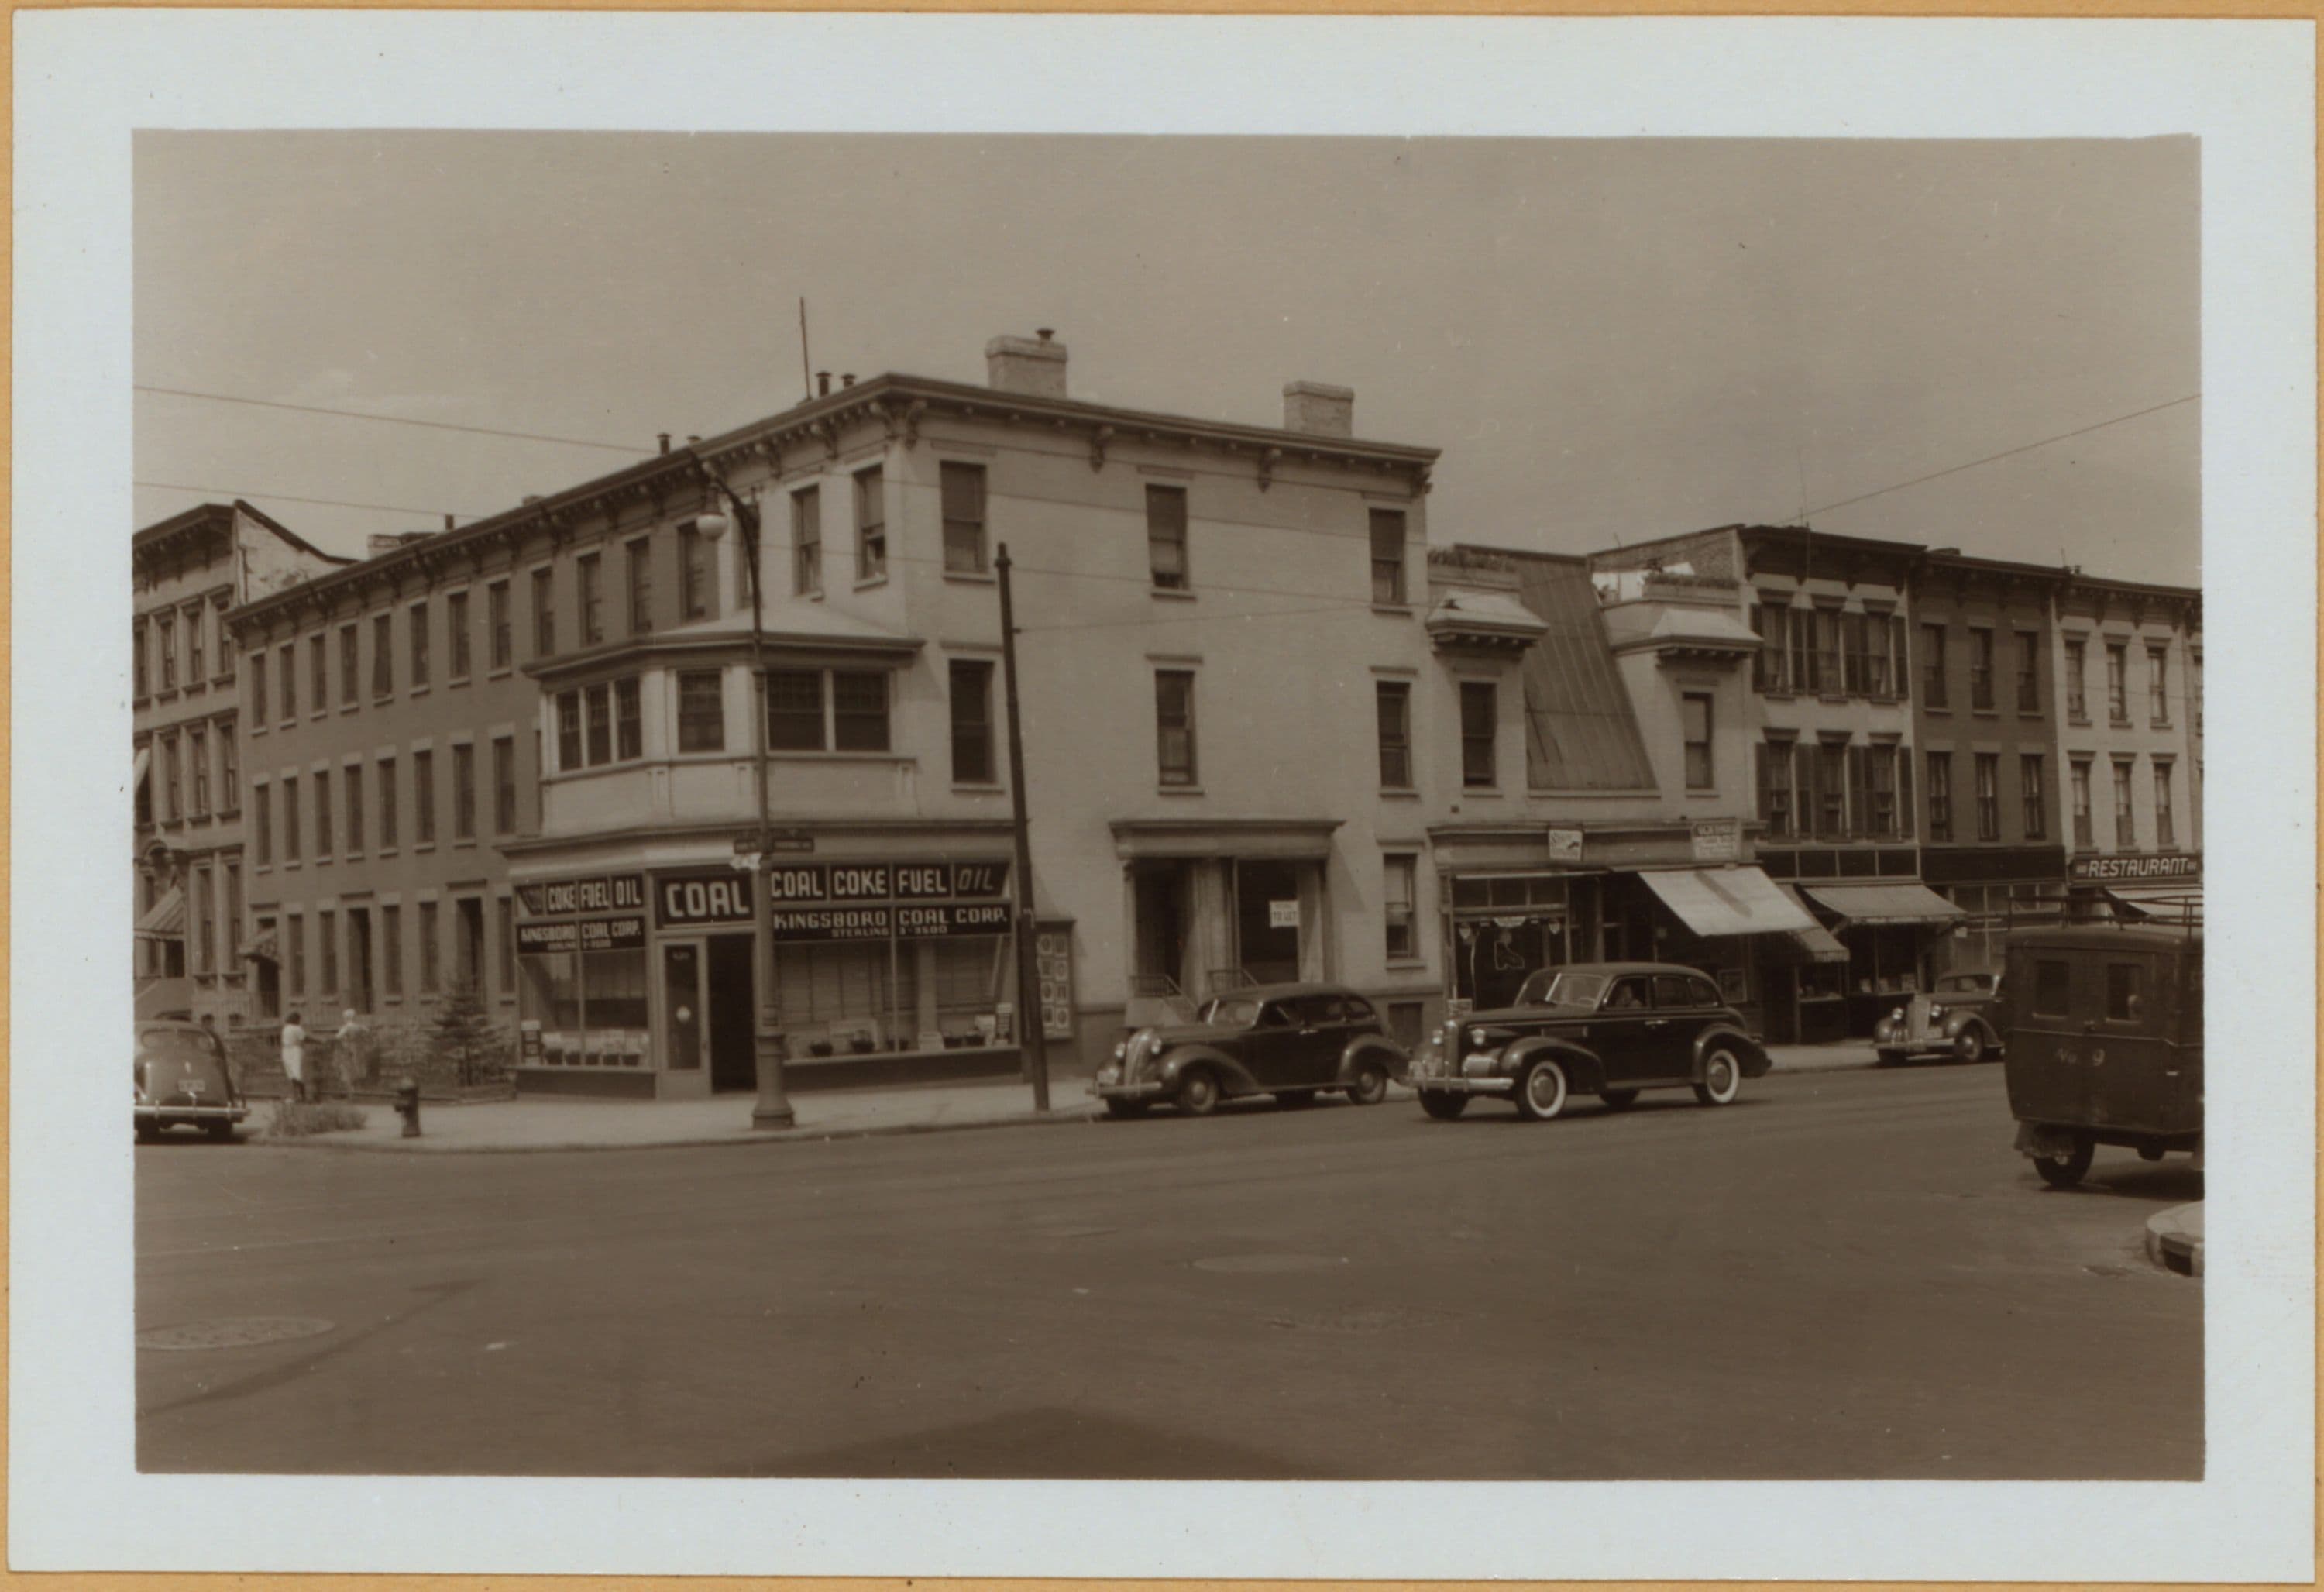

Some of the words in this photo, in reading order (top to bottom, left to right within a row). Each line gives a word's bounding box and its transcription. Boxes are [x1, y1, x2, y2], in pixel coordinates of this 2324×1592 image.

[2088, 857, 2188, 878] RESTAURANT
[771, 868, 823, 898] COAL
[834, 867, 887, 896] COKE
[898, 865, 947, 893] FUEL
[957, 866, 993, 891] OIL
[548, 885, 576, 911] COKE
[580, 882, 609, 909] FUEL
[615, 879, 641, 905] OIL
[665, 879, 750, 918] COAL
[773, 910, 887, 930] KINGSBORO
[898, 909, 950, 926] COAL
[955, 907, 1008, 923] CORP.
[581, 922, 610, 939] COAL
[831, 927, 889, 938] STERLING
